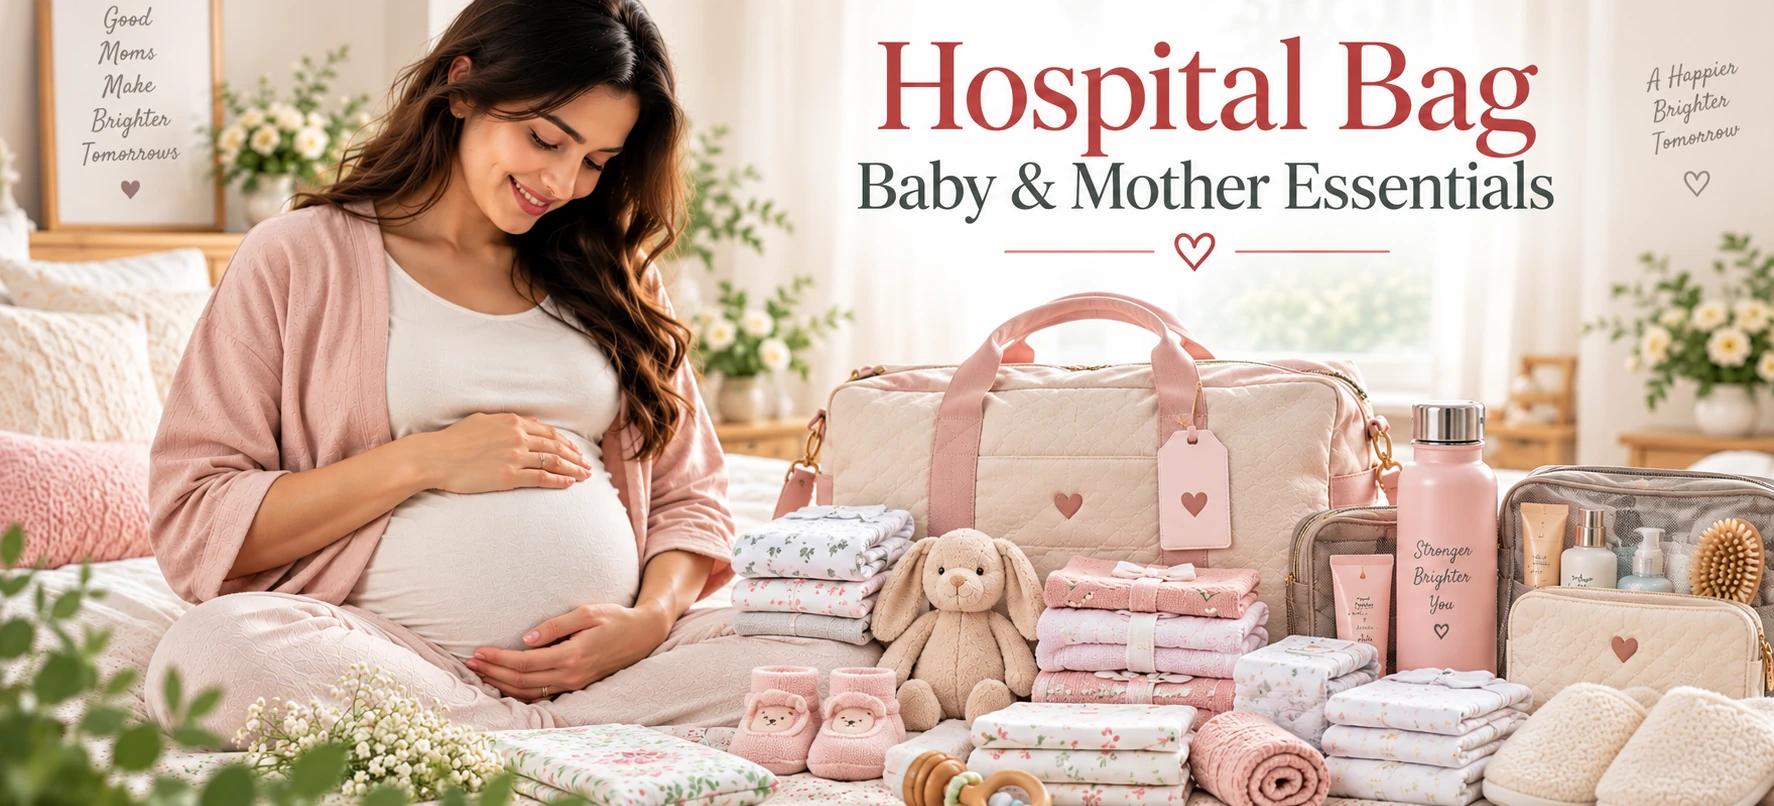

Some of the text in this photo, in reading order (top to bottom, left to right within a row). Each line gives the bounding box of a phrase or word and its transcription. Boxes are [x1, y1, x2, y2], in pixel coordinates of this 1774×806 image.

[103, 5, 153, 35] Good
[98, 40, 157, 65] Moms
[102, 74, 156, 99] Make
[1646, 61, 1739, 93] A Happier
[1653, 92, 1730, 124] Brighter
[91, 108, 171, 138] Brighter
[1652, 125, 1741, 155] Tomorrow
[82, 141, 181, 166] Tomorrows
[1414, 540, 1473, 563] Stronger
[1413, 566, 1472, 590] Brighter
[1429, 595, 1455, 615] You
